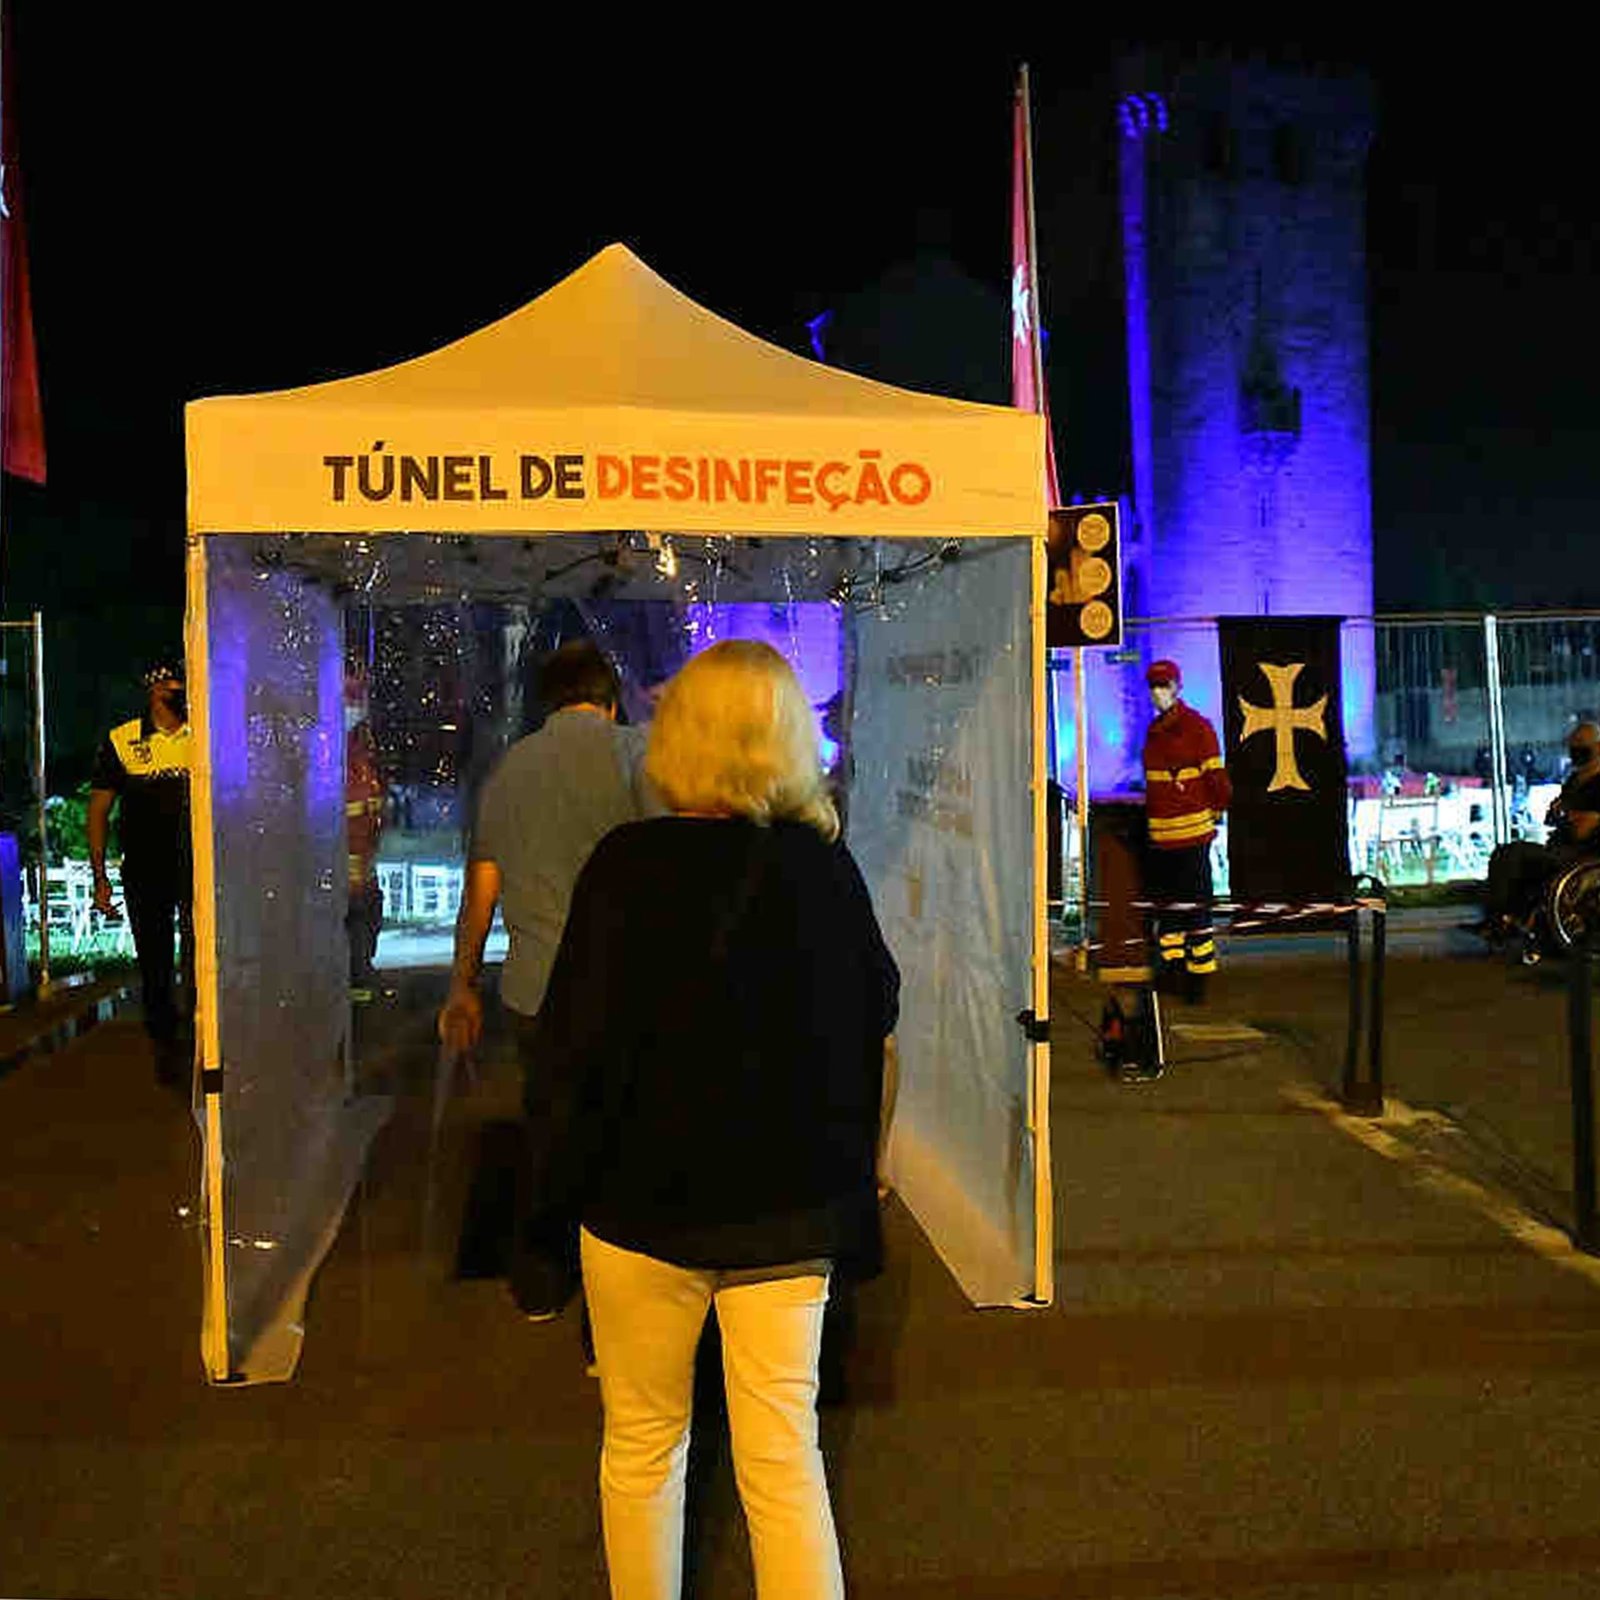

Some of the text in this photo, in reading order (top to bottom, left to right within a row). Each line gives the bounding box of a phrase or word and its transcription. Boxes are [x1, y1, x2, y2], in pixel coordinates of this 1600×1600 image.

[323, 440, 931, 512] TÚNEL DE DESINFEÇÃO
